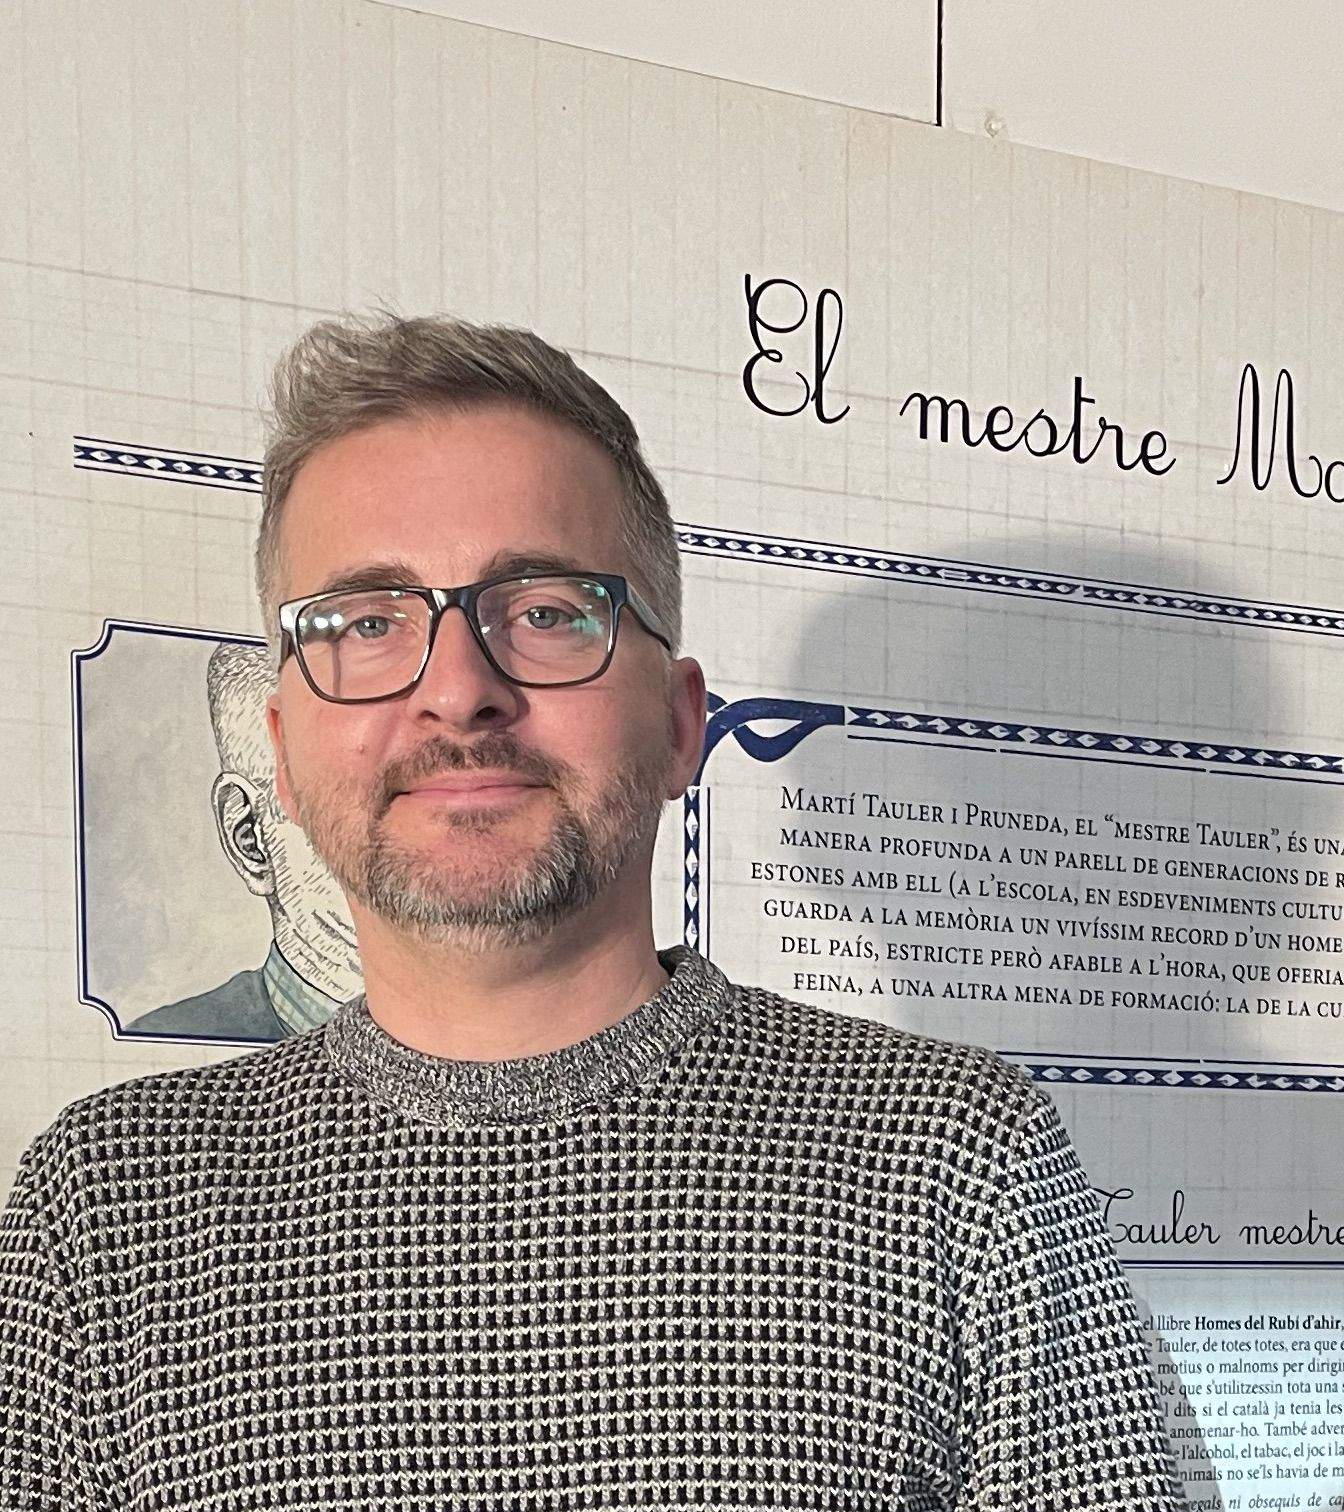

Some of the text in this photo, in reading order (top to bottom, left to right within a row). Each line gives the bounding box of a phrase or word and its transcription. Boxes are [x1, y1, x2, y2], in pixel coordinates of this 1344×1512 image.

[743, 274, 850, 424] El
[900, 377, 1176, 475] mestre
[1093, 1189, 1220, 1244] Tauler
